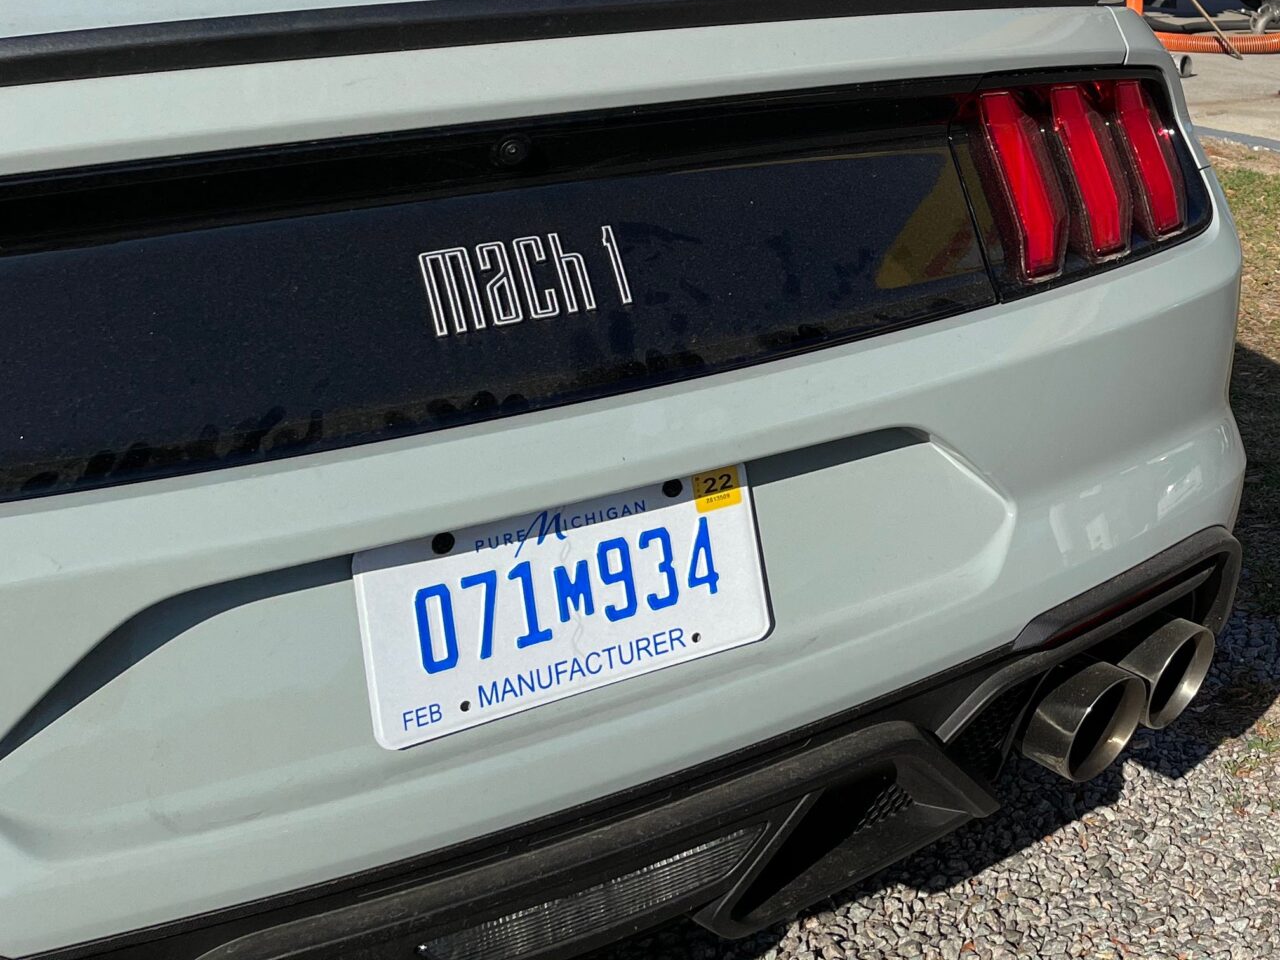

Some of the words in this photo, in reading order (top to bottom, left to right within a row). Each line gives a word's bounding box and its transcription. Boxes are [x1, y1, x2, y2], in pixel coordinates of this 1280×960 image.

[601, 224, 633, 306] 1
[703, 473, 734, 494] 22
[474, 529, 527, 553] PURE
[514, 499, 647, 559] MICHIGAN
[414, 516, 720, 675] 071M934
[401, 702, 443, 732] FEB
[477, 627, 687, 709] MANUFACTURER
